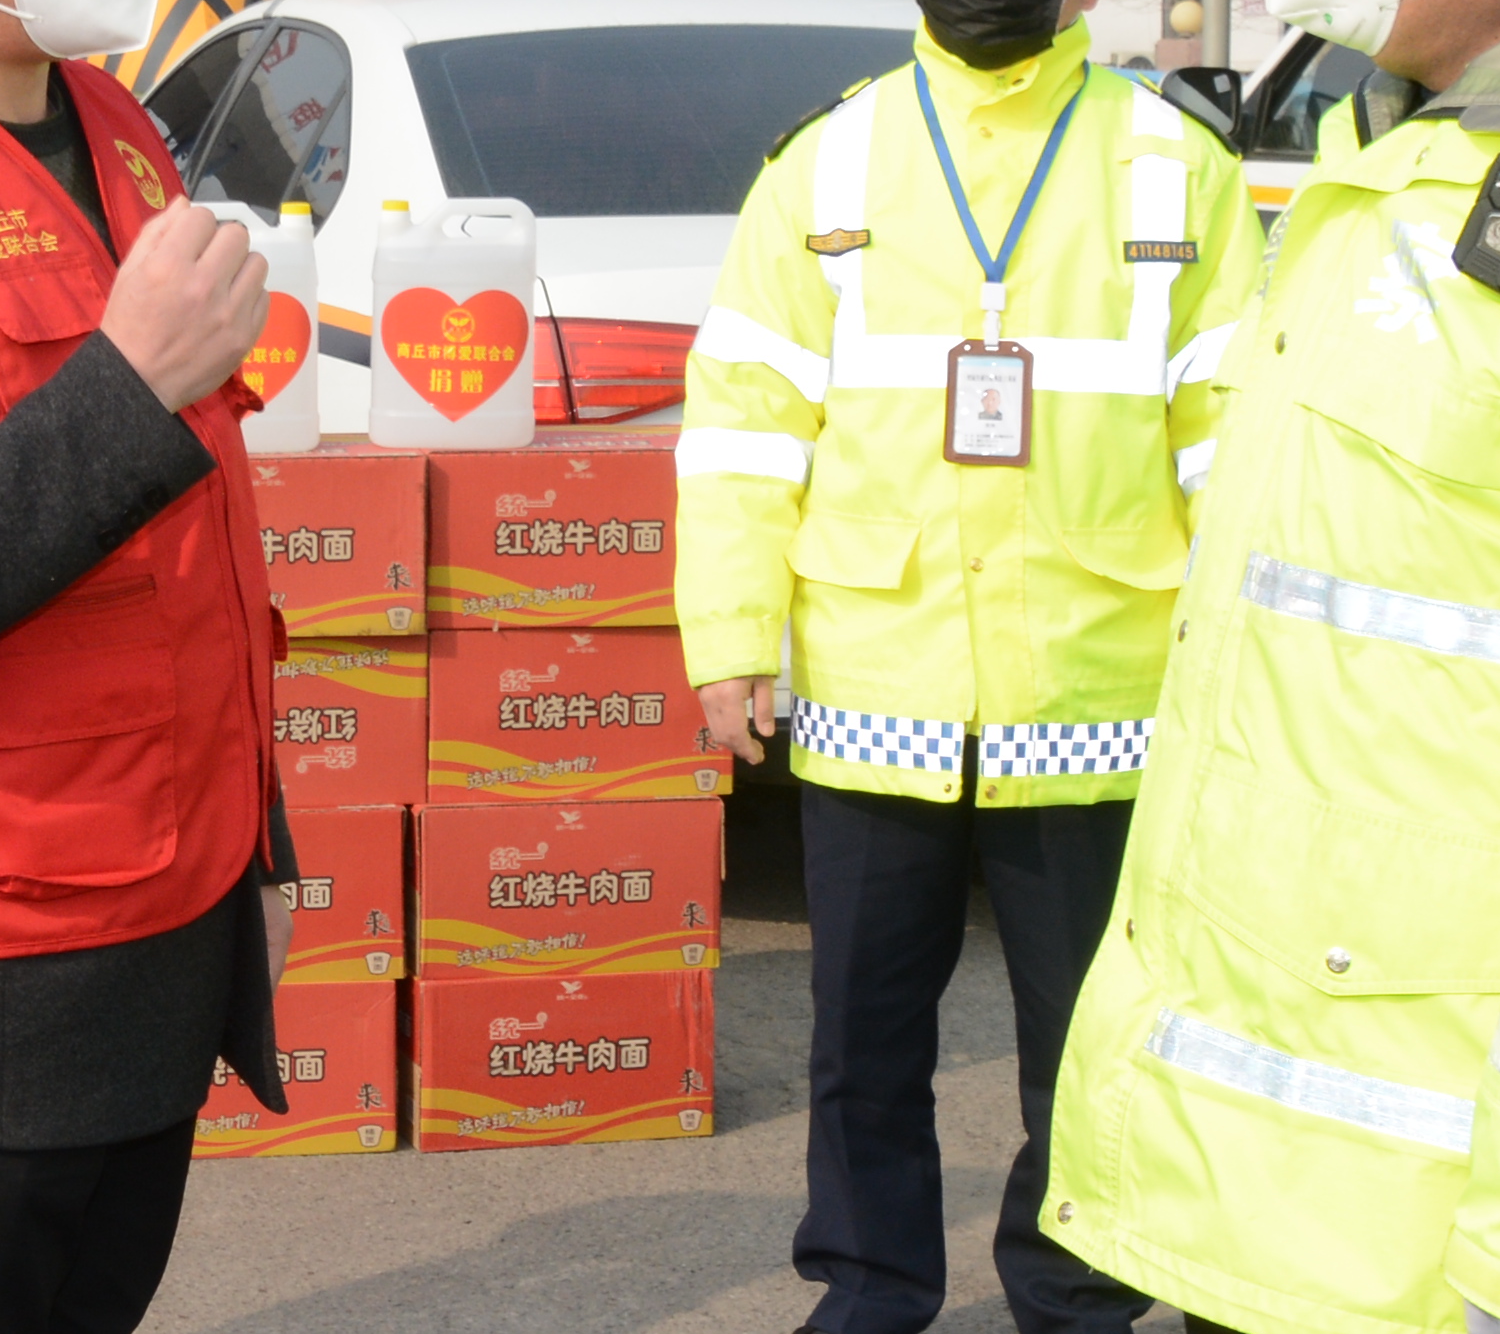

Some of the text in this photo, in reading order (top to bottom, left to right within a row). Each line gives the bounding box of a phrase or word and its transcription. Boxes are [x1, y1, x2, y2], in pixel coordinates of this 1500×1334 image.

[396, 343, 515, 364] 商丘市博爱联合会
[429, 369, 484, 394] 捐赠
[495, 518, 664, 556] 红烧牛肉面
[499, 693, 665, 730] 红烧牛肉面
[489, 870, 654, 909] 红烧牛肉面
[489, 1038, 651, 1078] 红烧牛肉面
